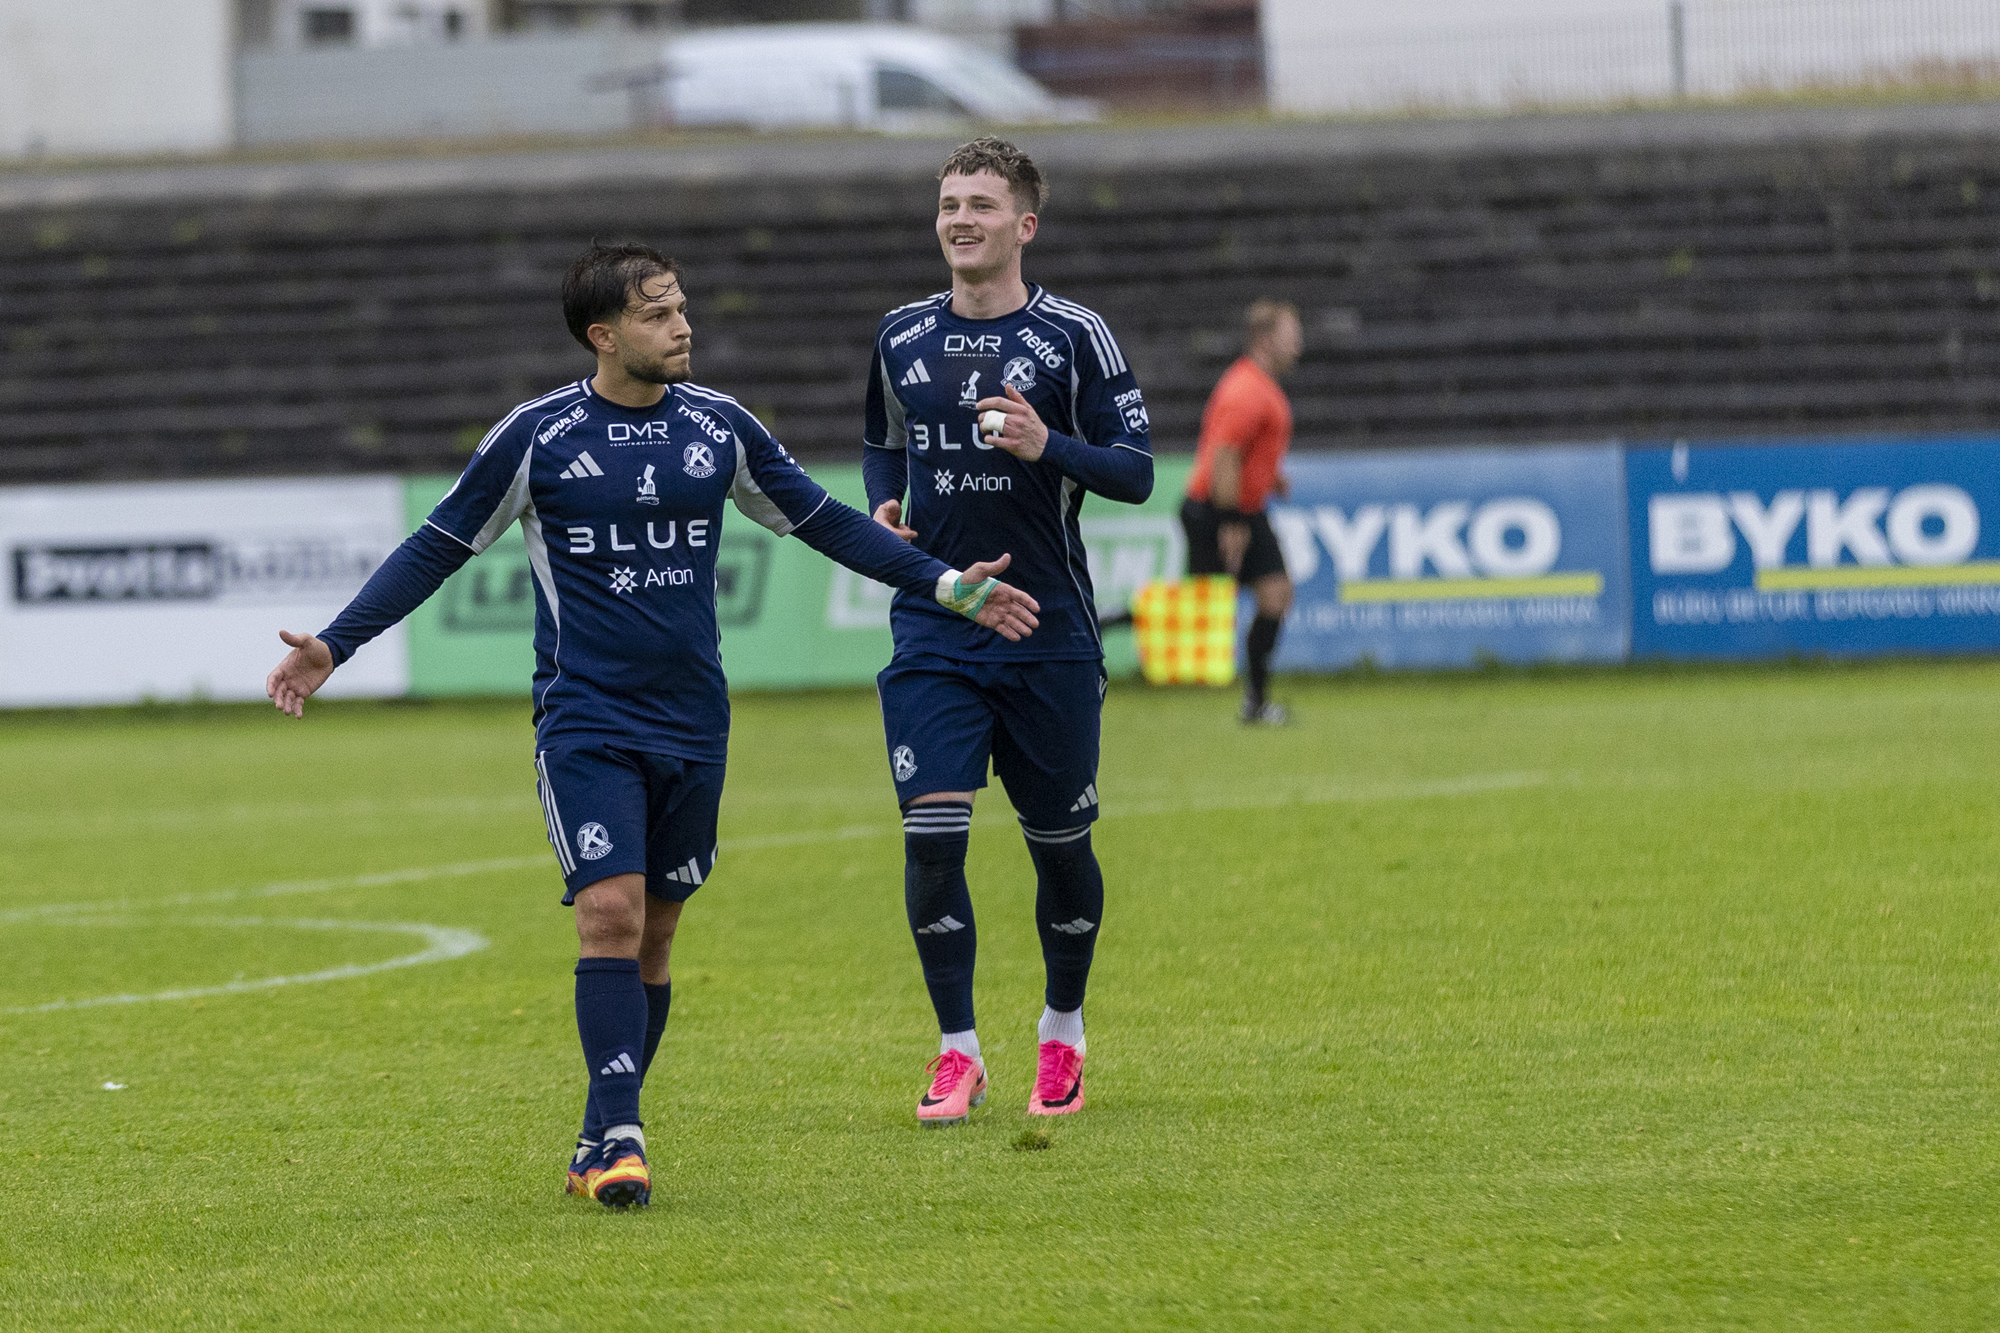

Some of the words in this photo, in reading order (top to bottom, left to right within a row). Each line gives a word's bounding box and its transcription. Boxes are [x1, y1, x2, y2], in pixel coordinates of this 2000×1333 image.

[944, 334, 1002, 352] OMR
[607, 421, 669, 441] OMR
[913, 423, 999, 450] BLU
[960, 473, 1012, 491] Arion
[567, 519, 709, 553] BLUE
[1648, 484, 1980, 574] BYKO
[644, 567, 693, 588] Arion
